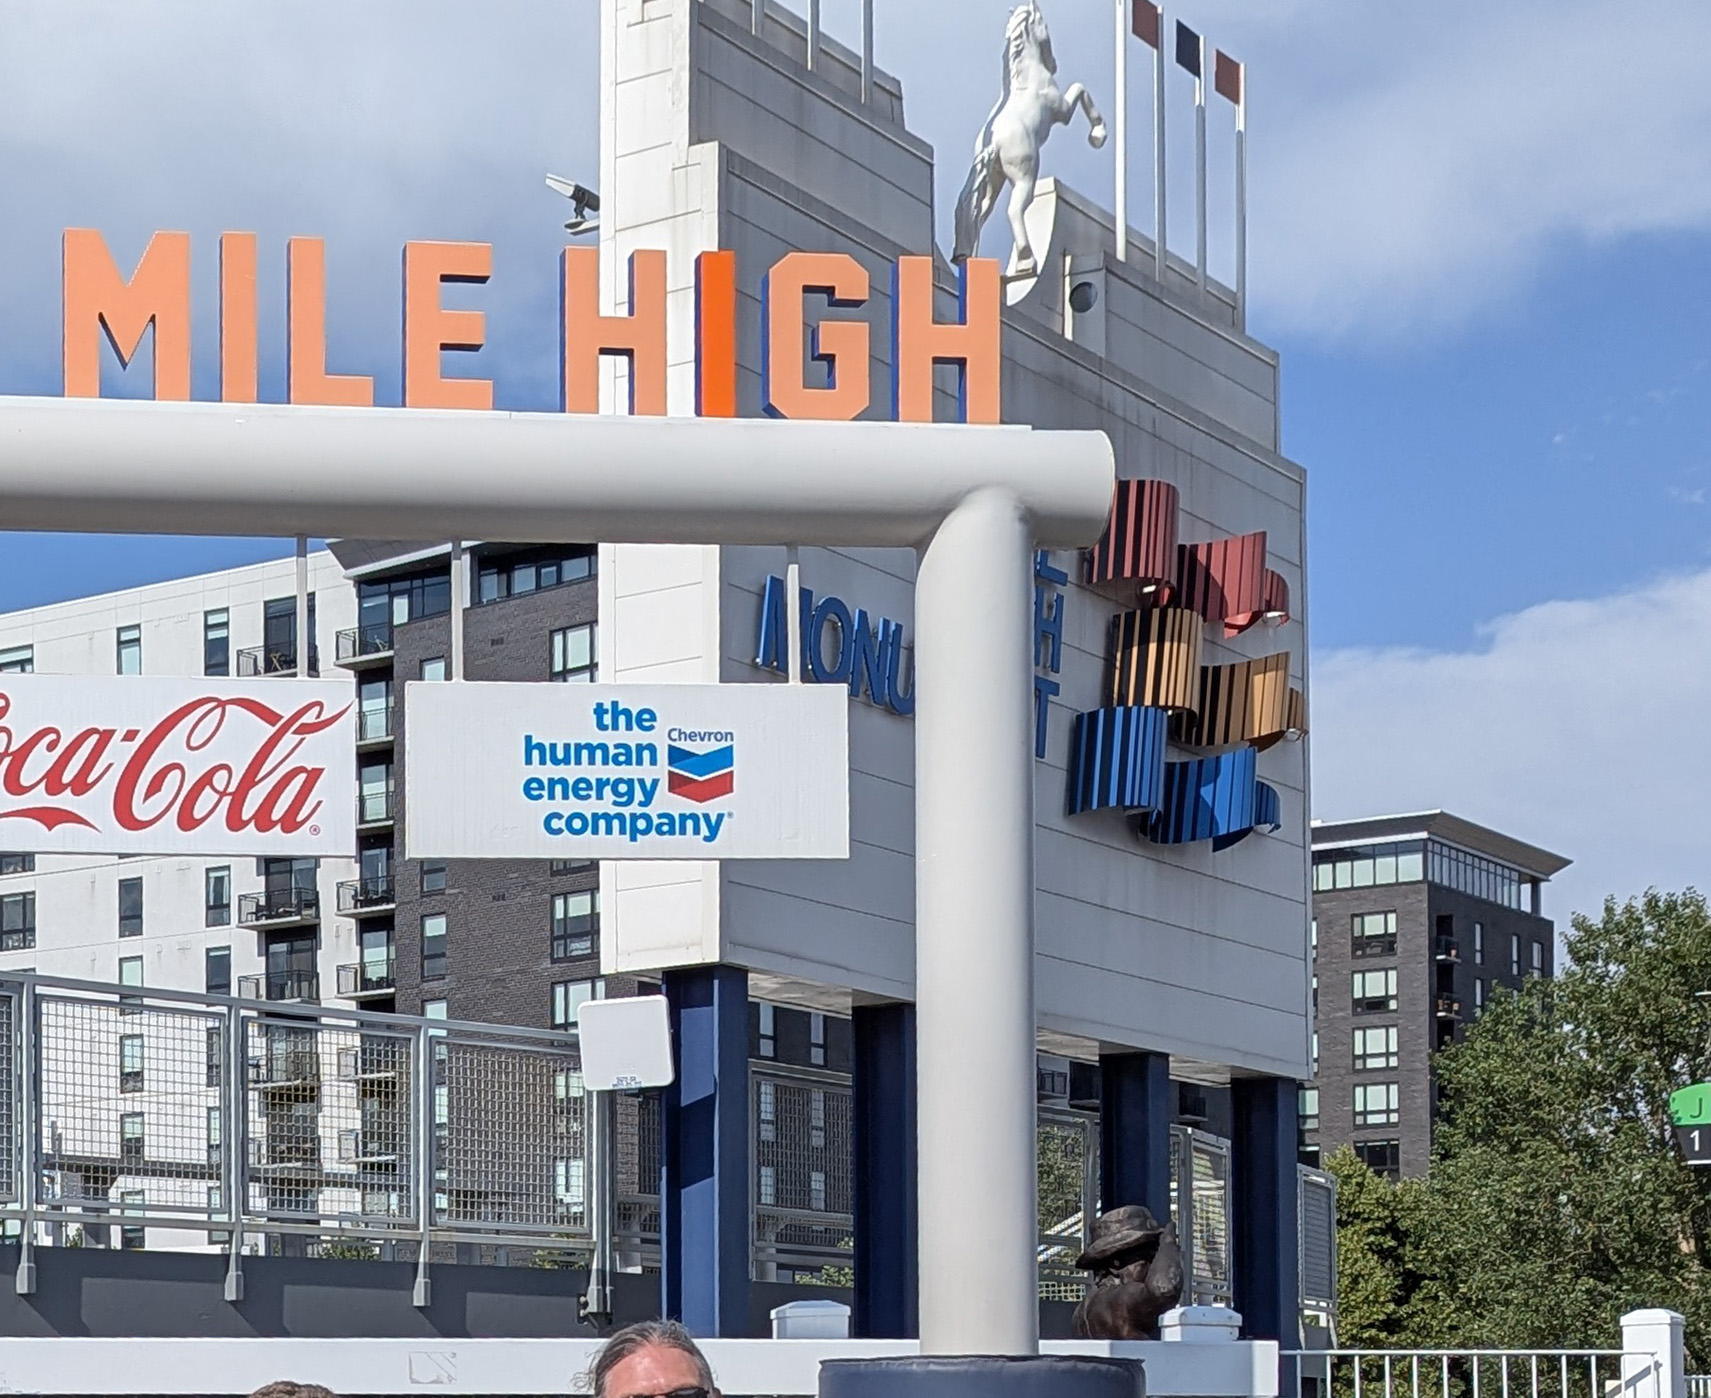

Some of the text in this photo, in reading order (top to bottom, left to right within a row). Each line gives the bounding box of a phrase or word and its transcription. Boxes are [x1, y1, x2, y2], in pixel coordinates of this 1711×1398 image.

[62, 228, 494, 409] MILE
[561, 245, 1001, 424] HIGH
[593, 700, 658, 732] the
[524, 735, 658, 766] human
[667, 728, 734, 742] Chevron
[523, 777, 660, 808] energy
[543, 812, 725, 842] company
